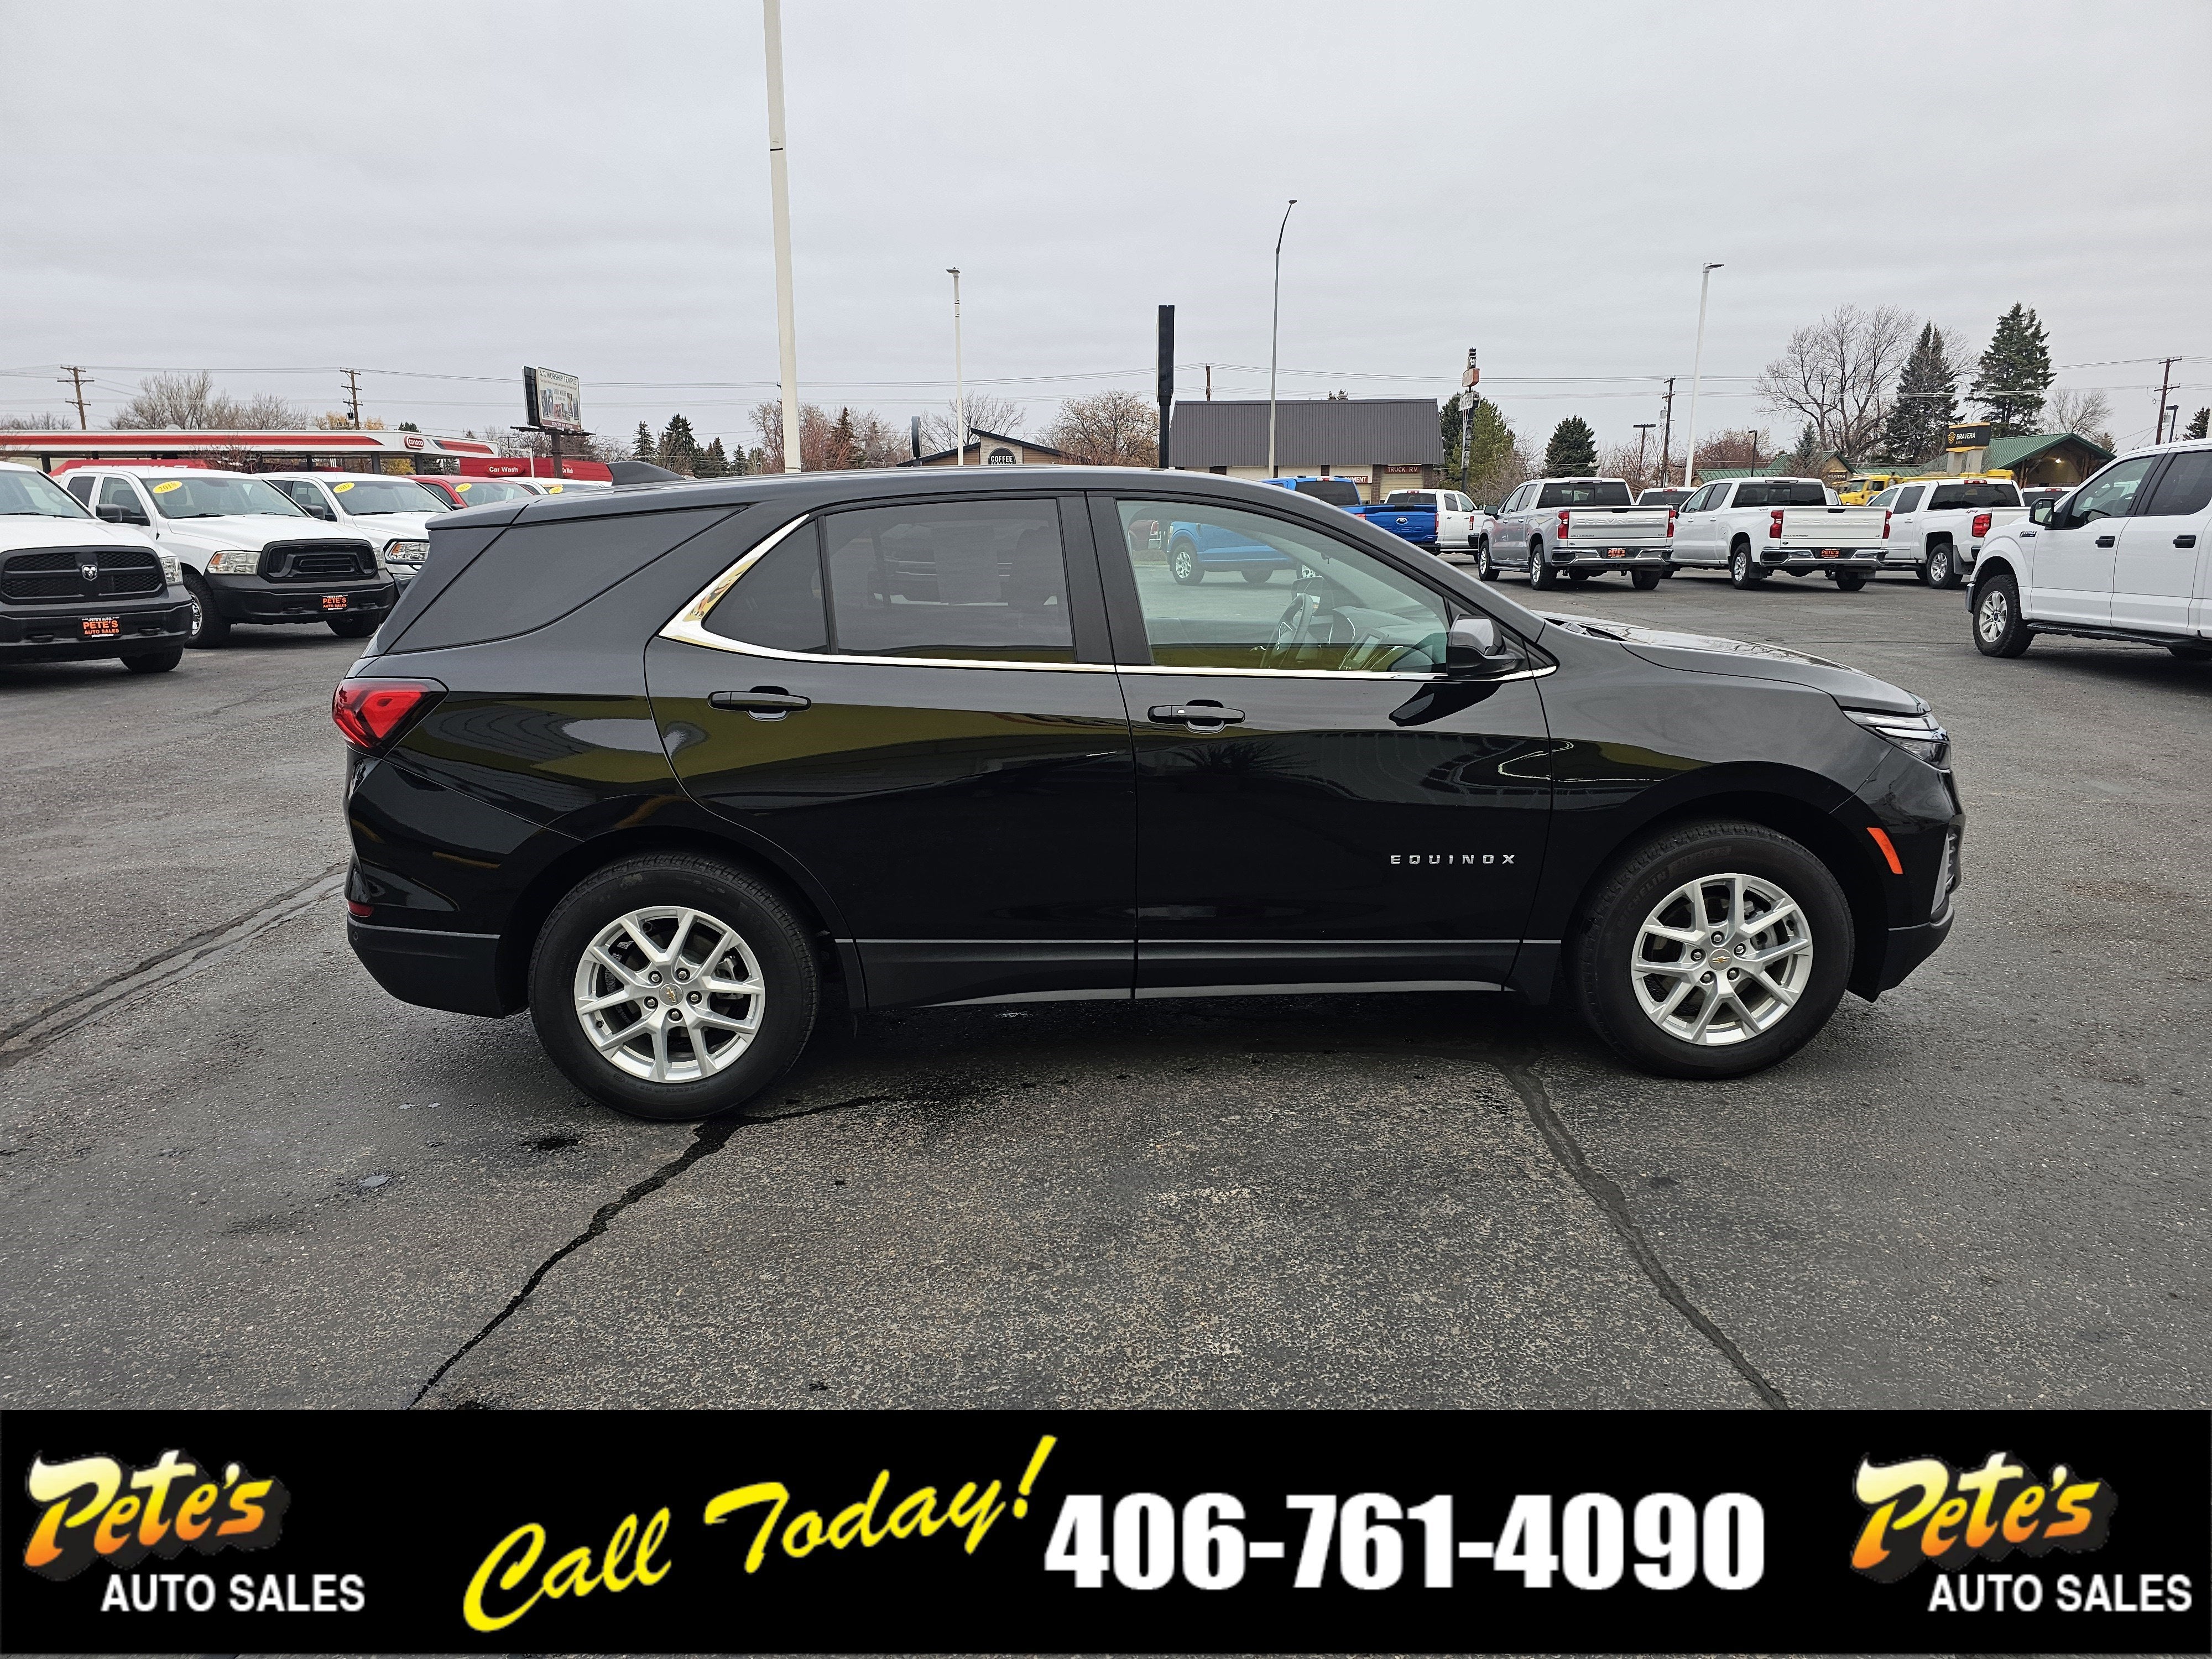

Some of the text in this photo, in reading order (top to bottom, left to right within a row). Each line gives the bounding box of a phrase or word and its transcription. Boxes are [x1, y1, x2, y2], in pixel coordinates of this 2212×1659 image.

[546, 372, 563, 382] WORSHIP
[564, 376, 577, 385] TEMPLE
[83, 620, 118, 630] PETE'S
[1390, 854, 1515, 865] EQUINOX
